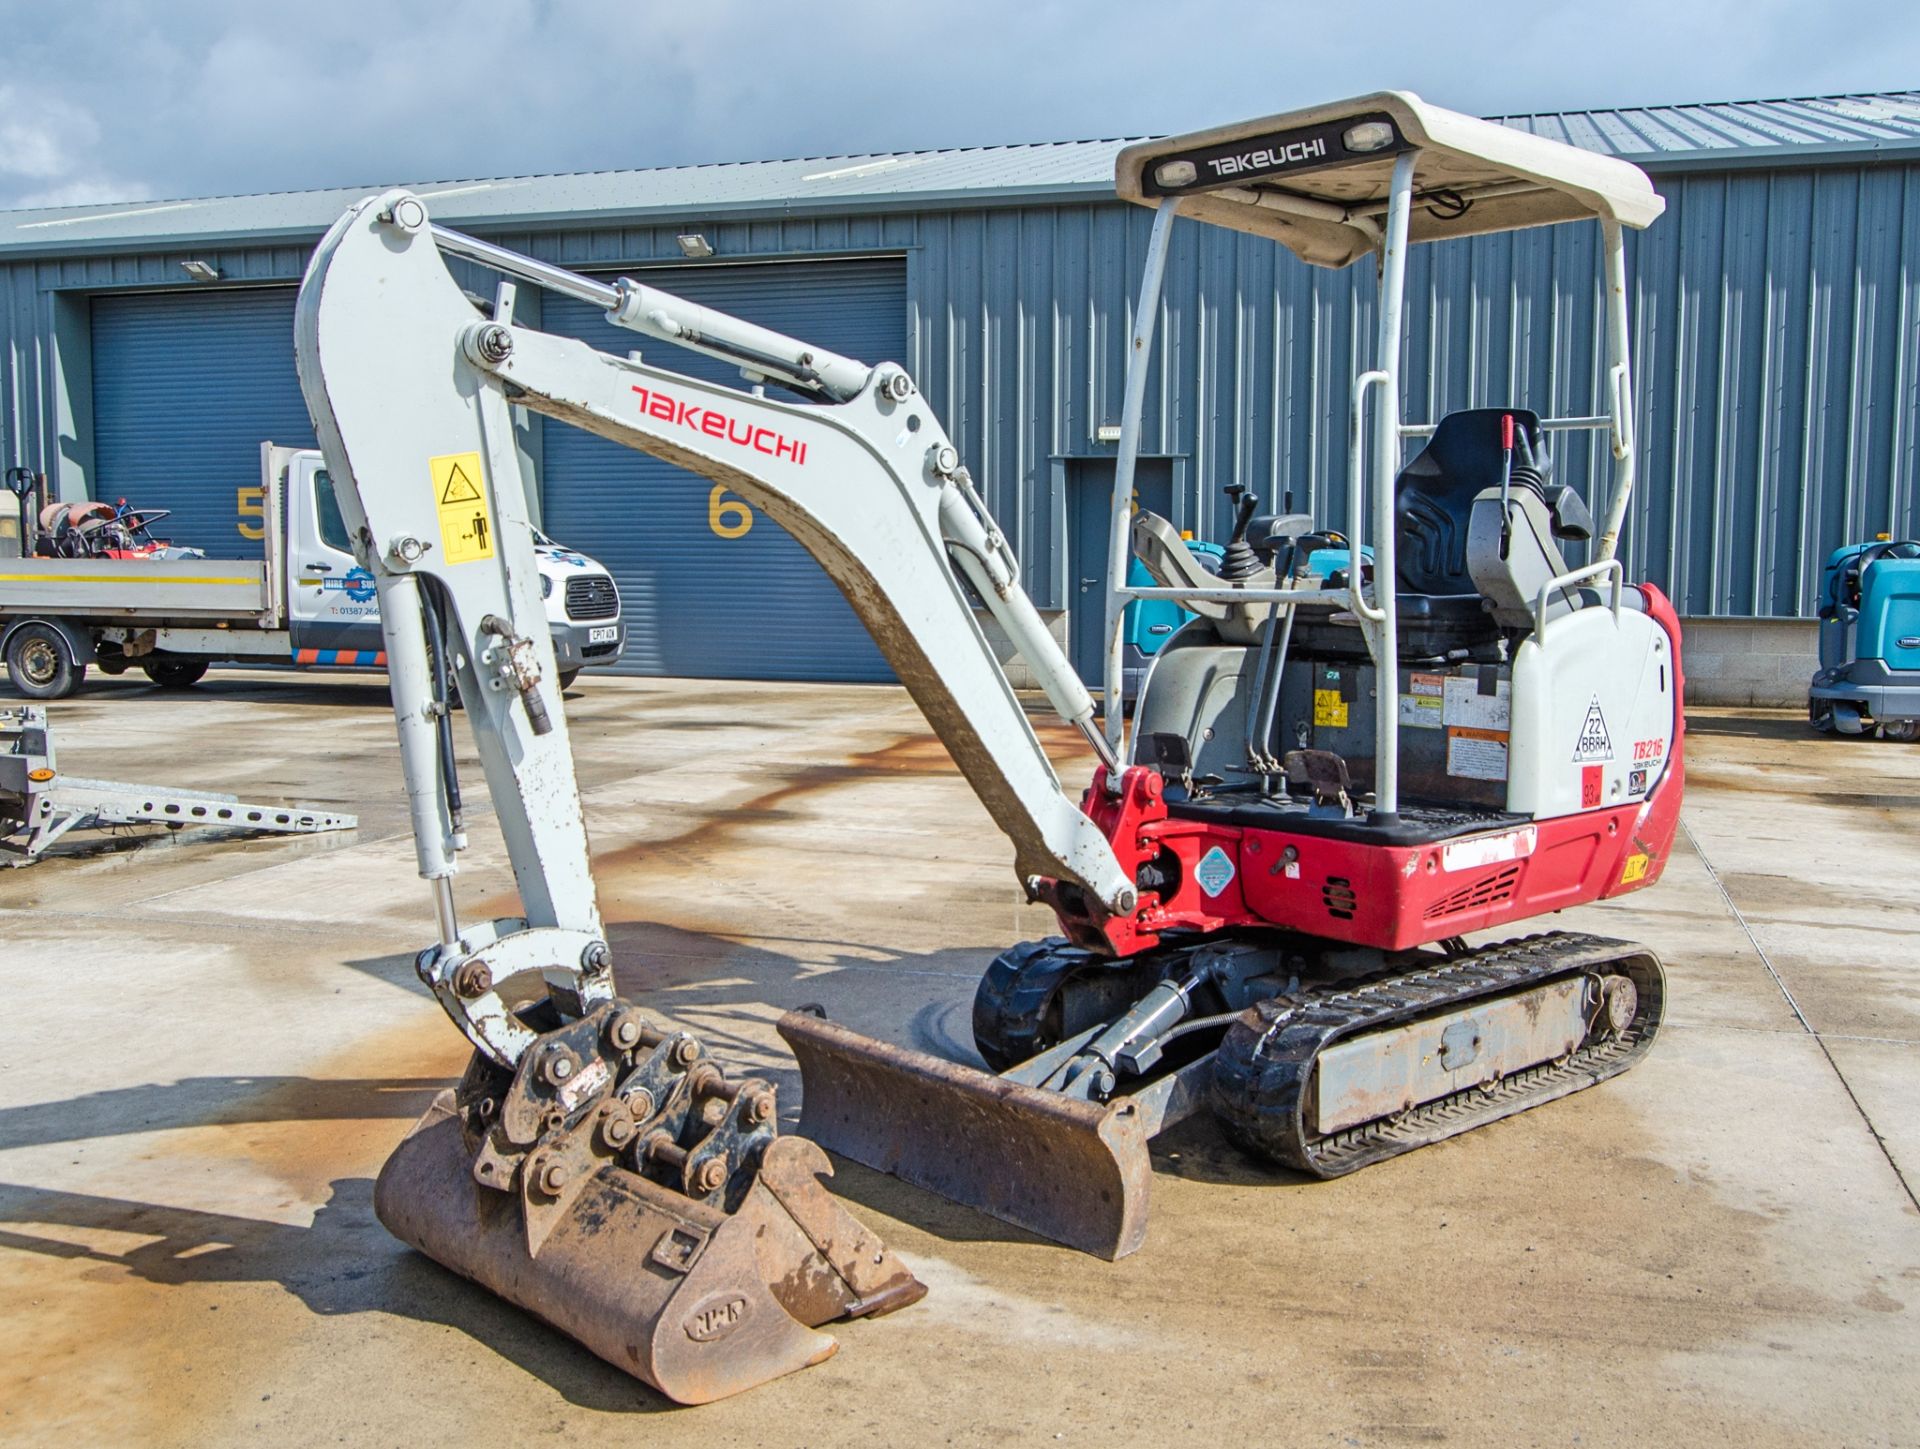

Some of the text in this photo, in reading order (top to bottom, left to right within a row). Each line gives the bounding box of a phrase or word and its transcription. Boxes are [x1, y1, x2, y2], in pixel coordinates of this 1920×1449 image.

[1208, 138, 1326, 175] TAKEUCHI
[631, 385, 807, 465] TAKEUCHI
[238, 487, 265, 540] 5
[709, 484, 753, 539] 6
[325, 579, 343, 588] HIRE
[340, 607, 363, 615] 01387
[1589, 718, 1601, 734] 22
[1633, 738, 1664, 760] TB216
[1584, 784, 1594, 805] 93
